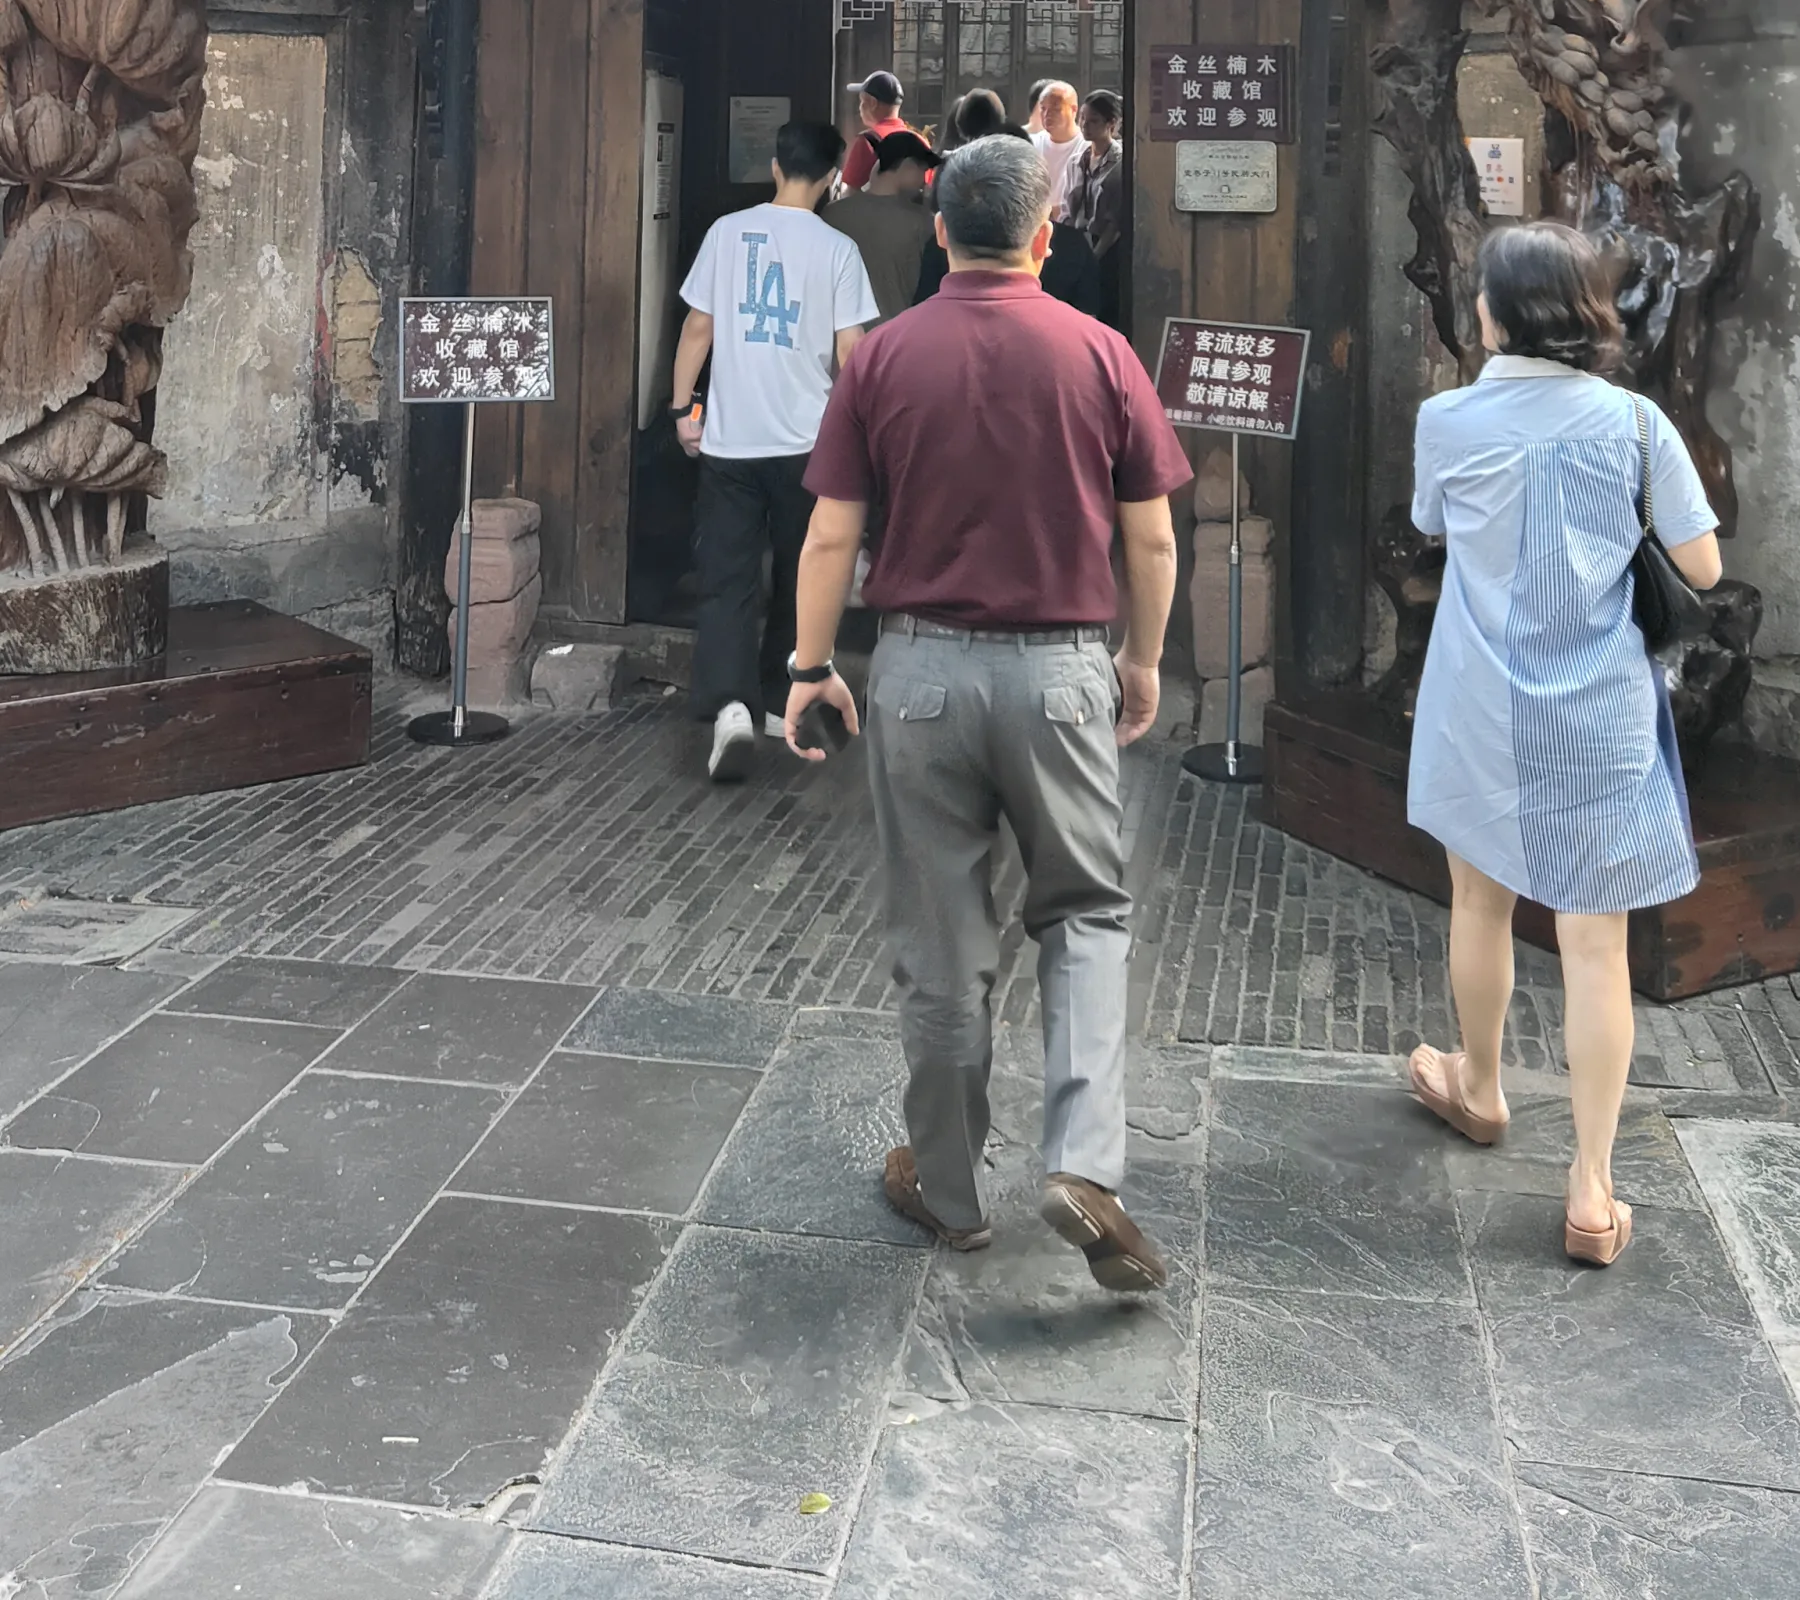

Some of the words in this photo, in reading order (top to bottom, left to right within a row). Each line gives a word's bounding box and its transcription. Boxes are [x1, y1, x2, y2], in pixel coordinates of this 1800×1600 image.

[1167, 54, 1277, 75] 金丝楠木
[1182, 80, 1262, 100] 收藏馆
[1167, 106, 1277, 127] 欢迎参观
[739, 232, 800, 349] LA
[419, 311, 534, 333] 金丝楠木
[435, 338, 520, 359] 收藏馆
[1194, 330, 1276, 358] 客流较多
[419, 366, 535, 389] 欢迎参观
[1189, 356, 1272, 386] 限量参观
[1186, 382, 1269, 412] 敬请谅解
[1206, 412, 1285, 433] 小吃饮料请勿入内
